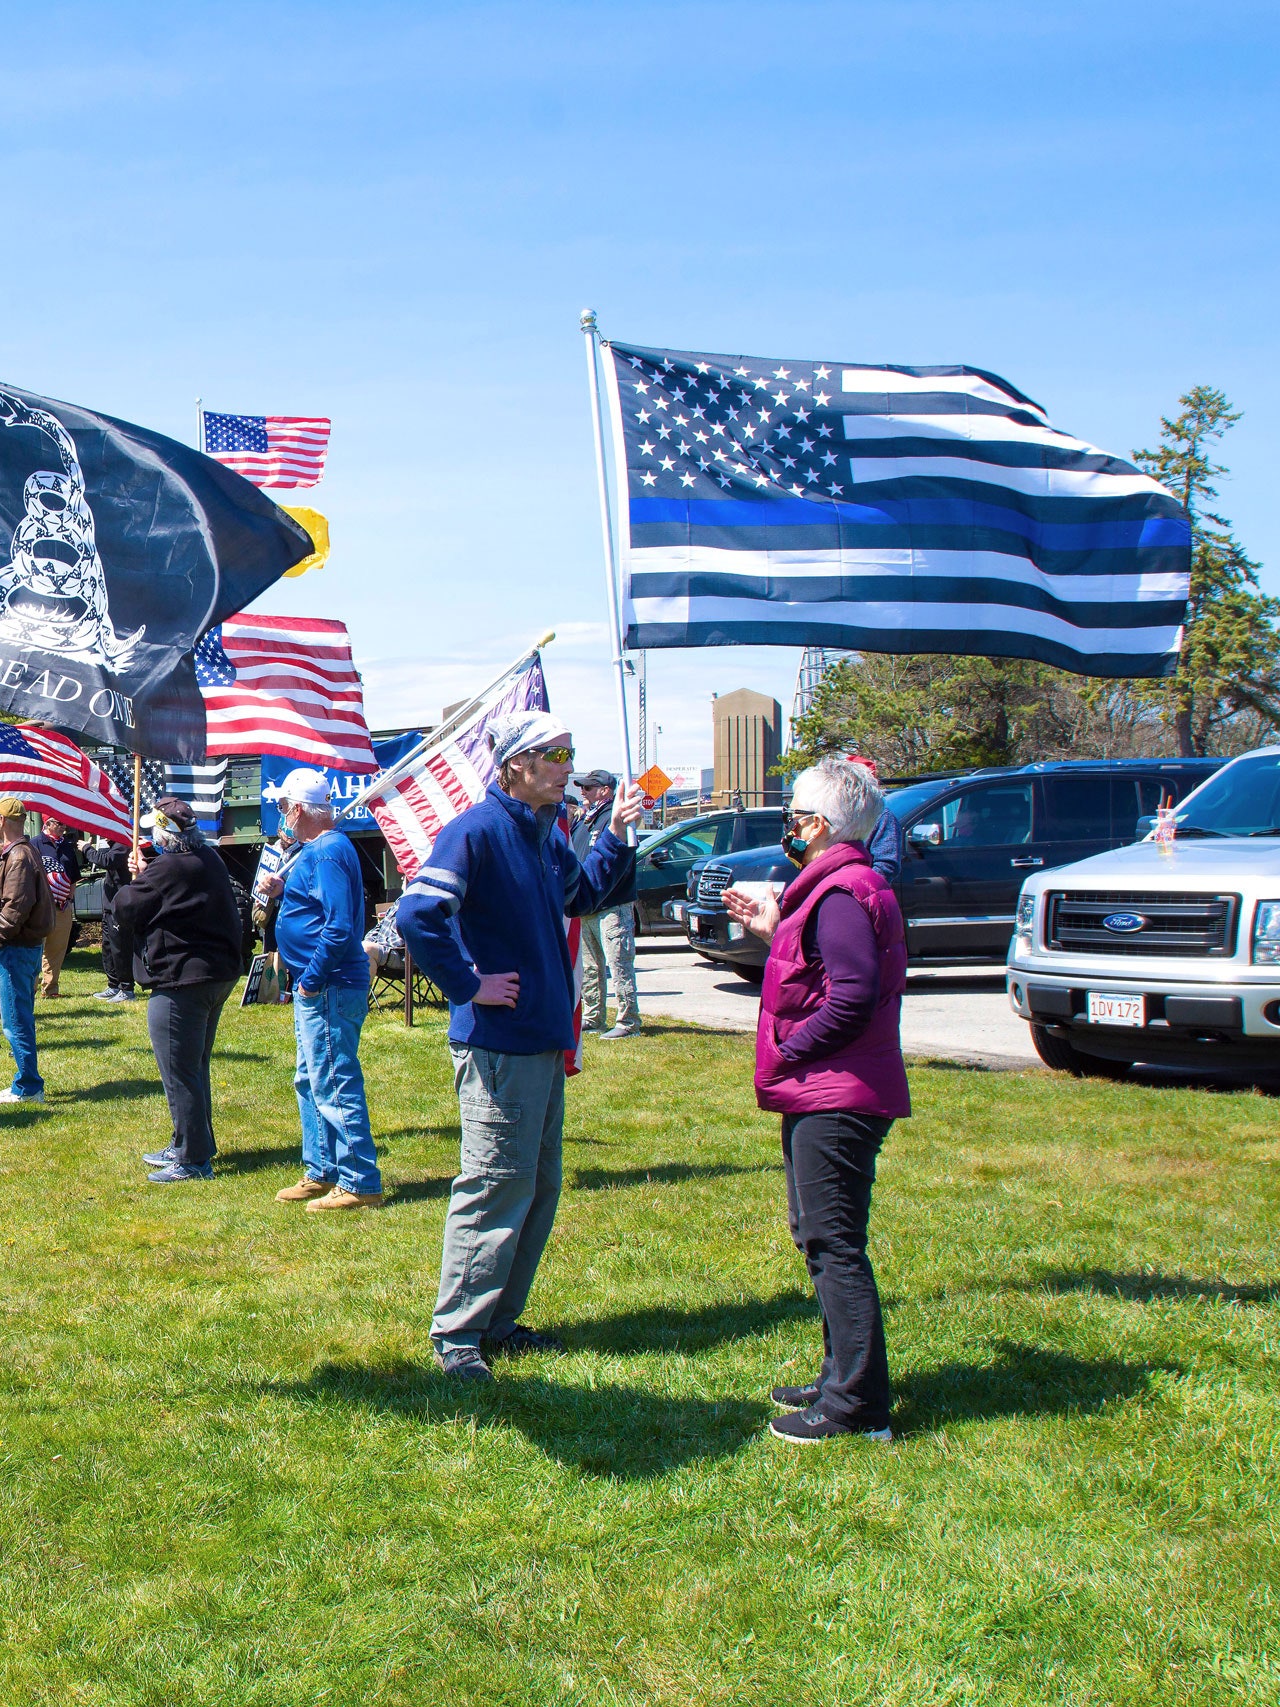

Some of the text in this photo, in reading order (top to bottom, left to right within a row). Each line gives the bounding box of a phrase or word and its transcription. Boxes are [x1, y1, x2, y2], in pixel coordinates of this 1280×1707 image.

[1110, 916, 1134, 927] Ford
[1091, 1001, 1140, 1019] 1DV 172
